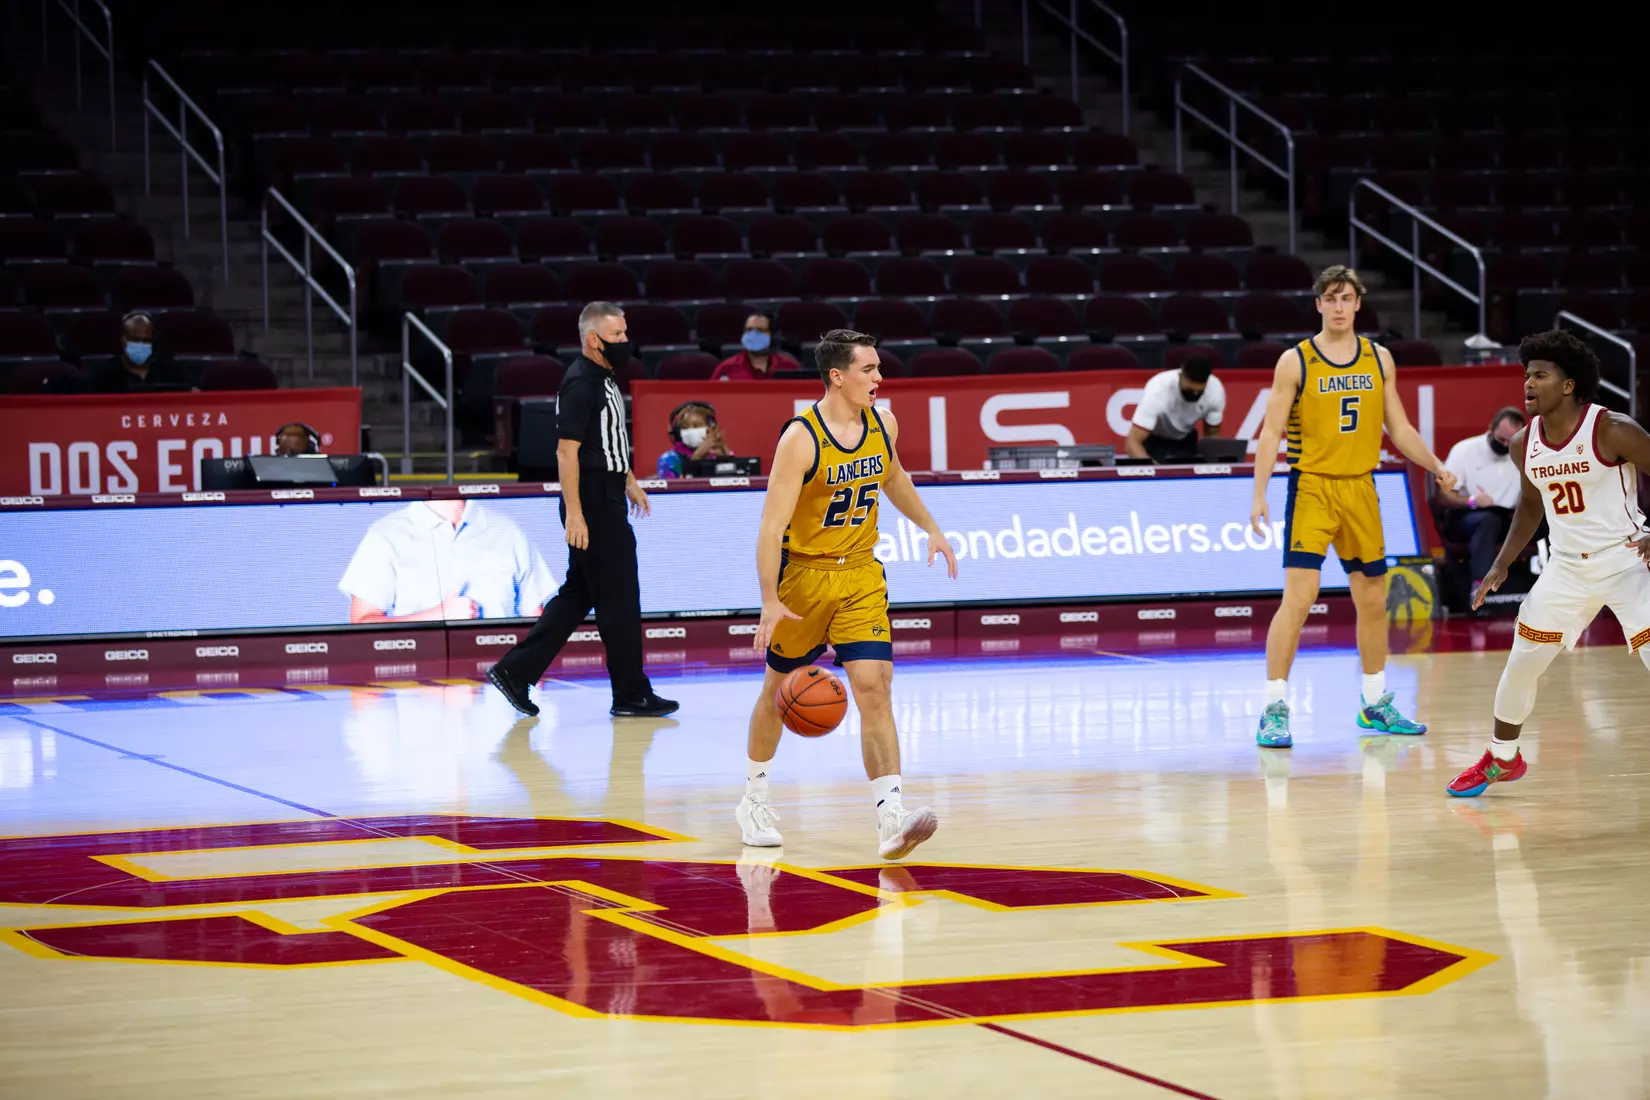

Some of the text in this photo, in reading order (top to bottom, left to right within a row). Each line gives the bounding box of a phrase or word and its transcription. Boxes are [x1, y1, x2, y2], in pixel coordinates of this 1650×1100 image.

[1318, 374, 1374, 393] LANCERS
[121, 412, 228, 428] CERVEZA
[1339, 395, 1361, 434] 5
[28, 440, 139, 495] DOS
[826, 454, 884, 485] LANCERS
[1531, 461, 1590, 479] TROJANS
[92, 494, 136, 503] GEICO
[822, 482, 879, 528] 25
[1548, 480, 1586, 515] 20
[374, 639, 416, 650] GEICO
[476, 634, 517, 645] GEICO
[105, 650, 149, 660] GEICO
[196, 646, 239, 656] GEICO
[286, 643, 328, 653] GEICO
[13, 653, 57, 663] GEICO
